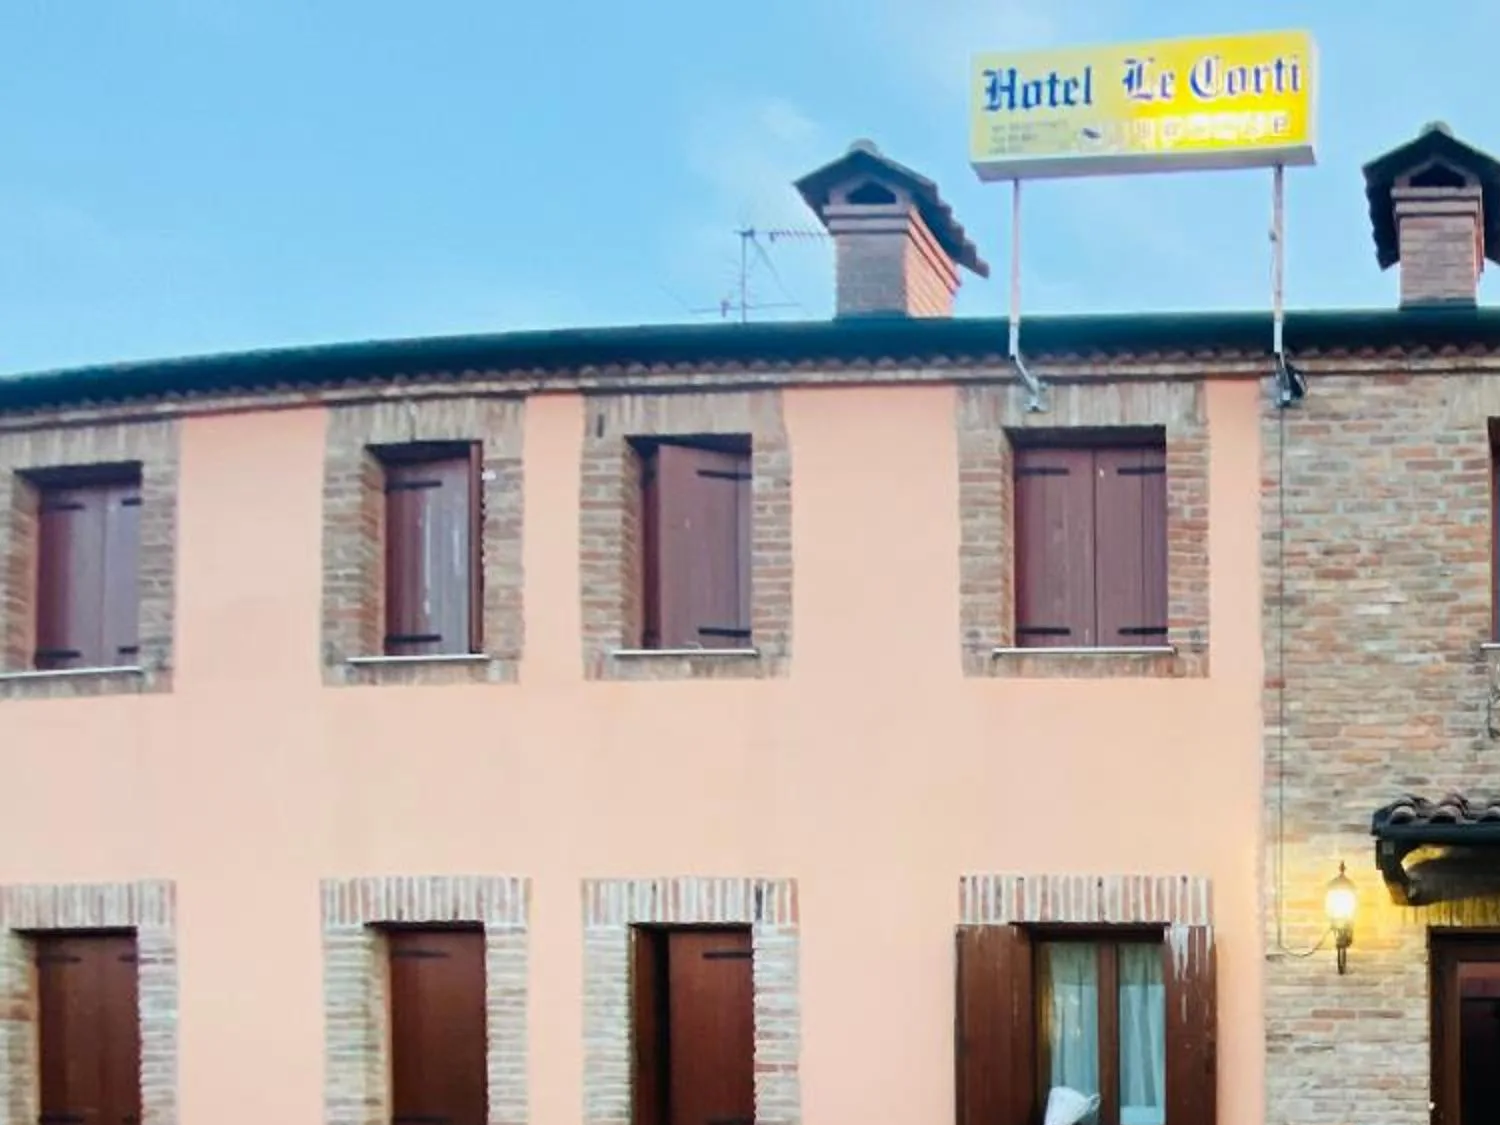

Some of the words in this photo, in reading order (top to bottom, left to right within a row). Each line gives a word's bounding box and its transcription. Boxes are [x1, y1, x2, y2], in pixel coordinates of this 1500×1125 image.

[982, 65, 1093, 112] Hotel
[1121, 57, 1175, 99] Le
[1189, 54, 1300, 98] Corti
